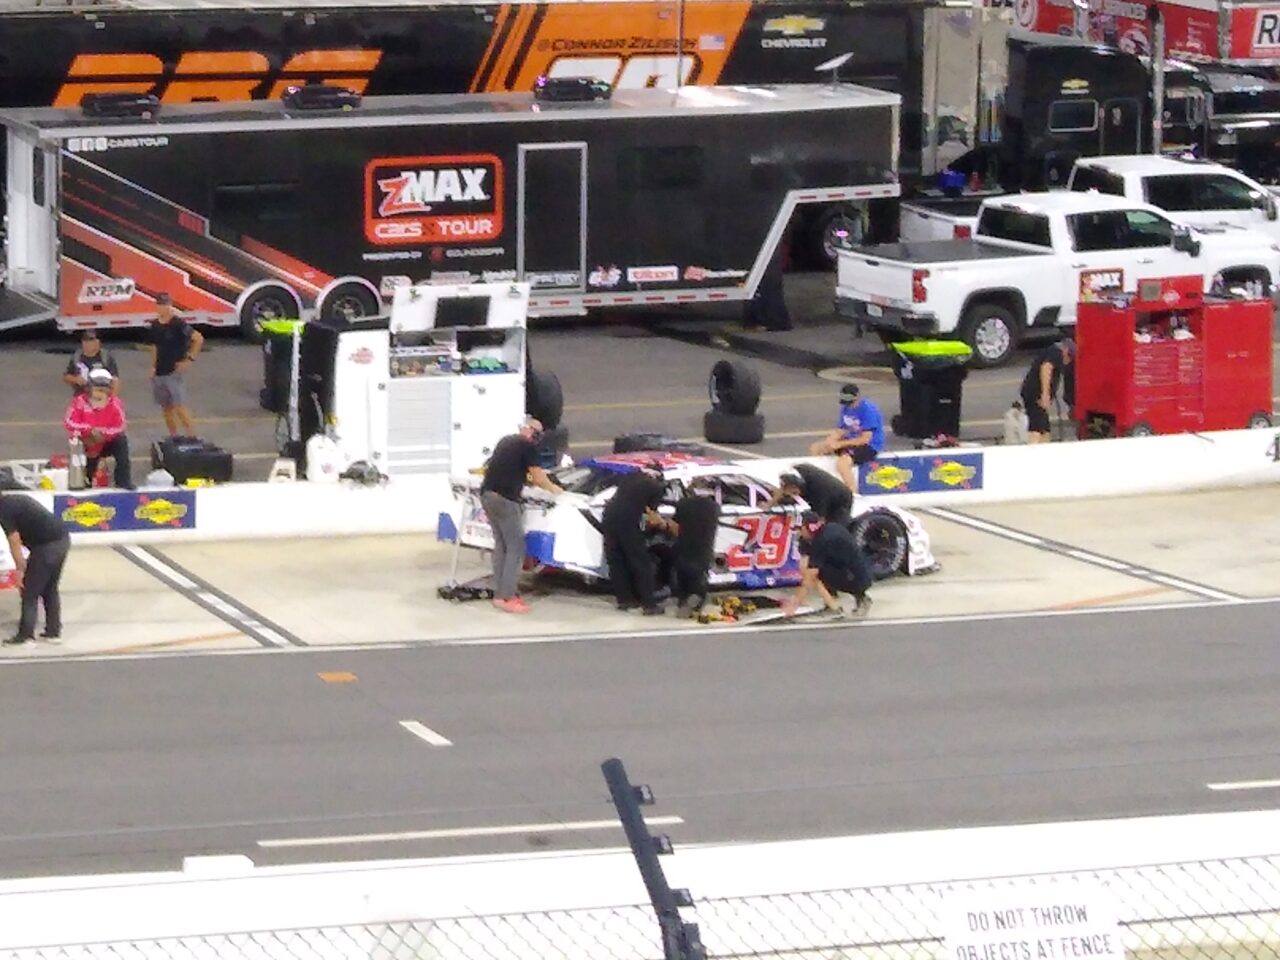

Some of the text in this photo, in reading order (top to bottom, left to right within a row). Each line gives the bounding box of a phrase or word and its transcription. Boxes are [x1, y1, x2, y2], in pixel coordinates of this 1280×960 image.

[377, 168, 488, 217] zMAX
[436, 218, 493, 236] TOUR
[724, 514, 793, 572] 29
[967, 904, 1088, 932] DO NOT THROW
[1037, 938, 1056, 959] AT
[1061, 933, 1115, 957] FENCE
